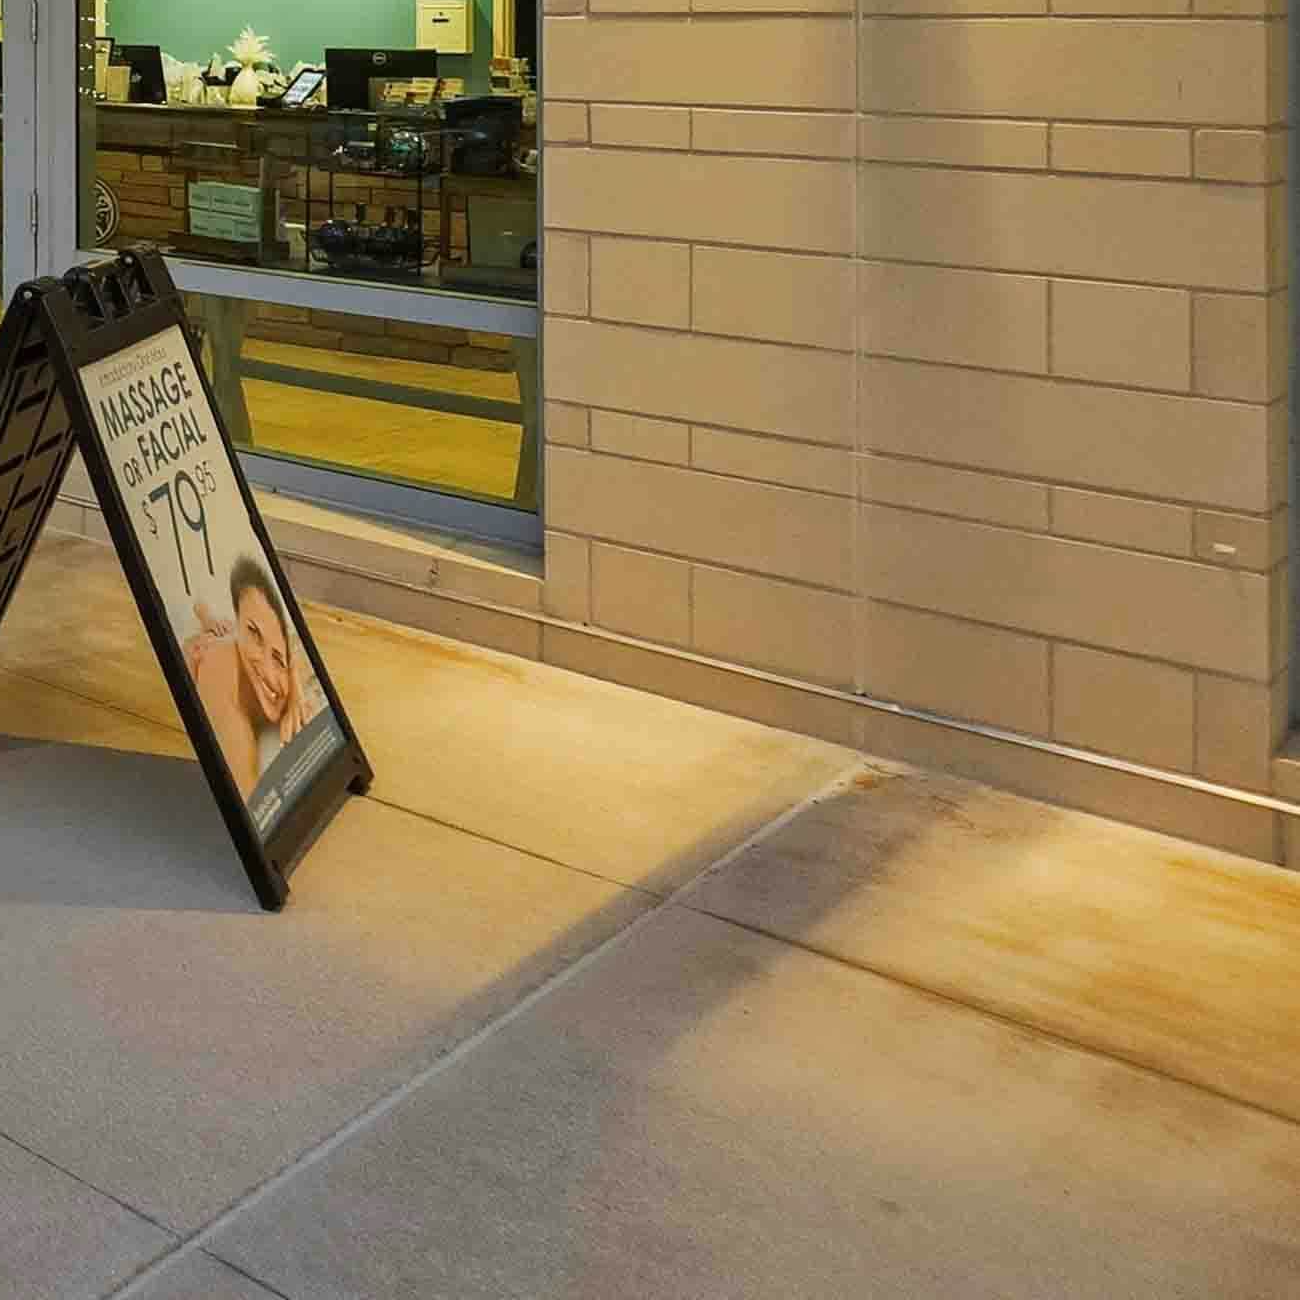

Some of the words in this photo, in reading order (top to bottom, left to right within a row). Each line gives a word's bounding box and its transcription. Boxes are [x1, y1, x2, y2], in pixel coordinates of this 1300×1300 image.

[100, 361, 193, 442] MASSAGE
[122, 457, 145, 488] OR
[136, 406, 208, 477] FACIAL
